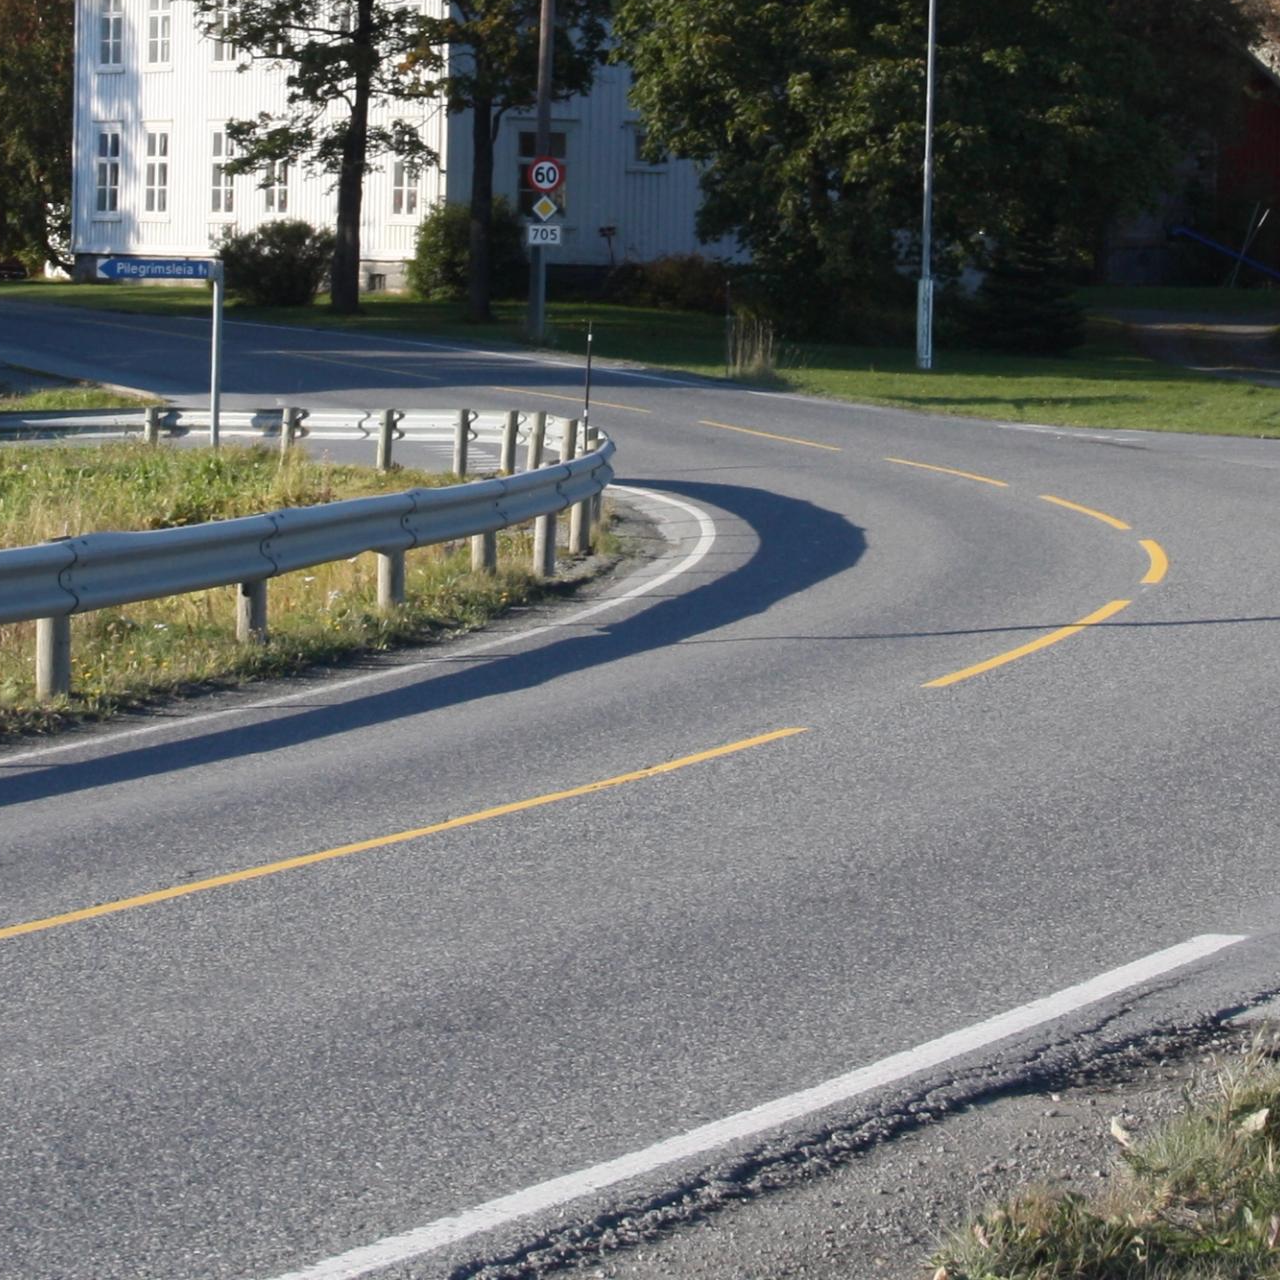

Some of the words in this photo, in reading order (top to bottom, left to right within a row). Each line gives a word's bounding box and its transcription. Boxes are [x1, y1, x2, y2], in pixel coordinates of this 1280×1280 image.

[535, 167, 557, 183] 60
[532, 228, 557, 240] 705
[116, 262, 193, 276] Pilegrimsleia
